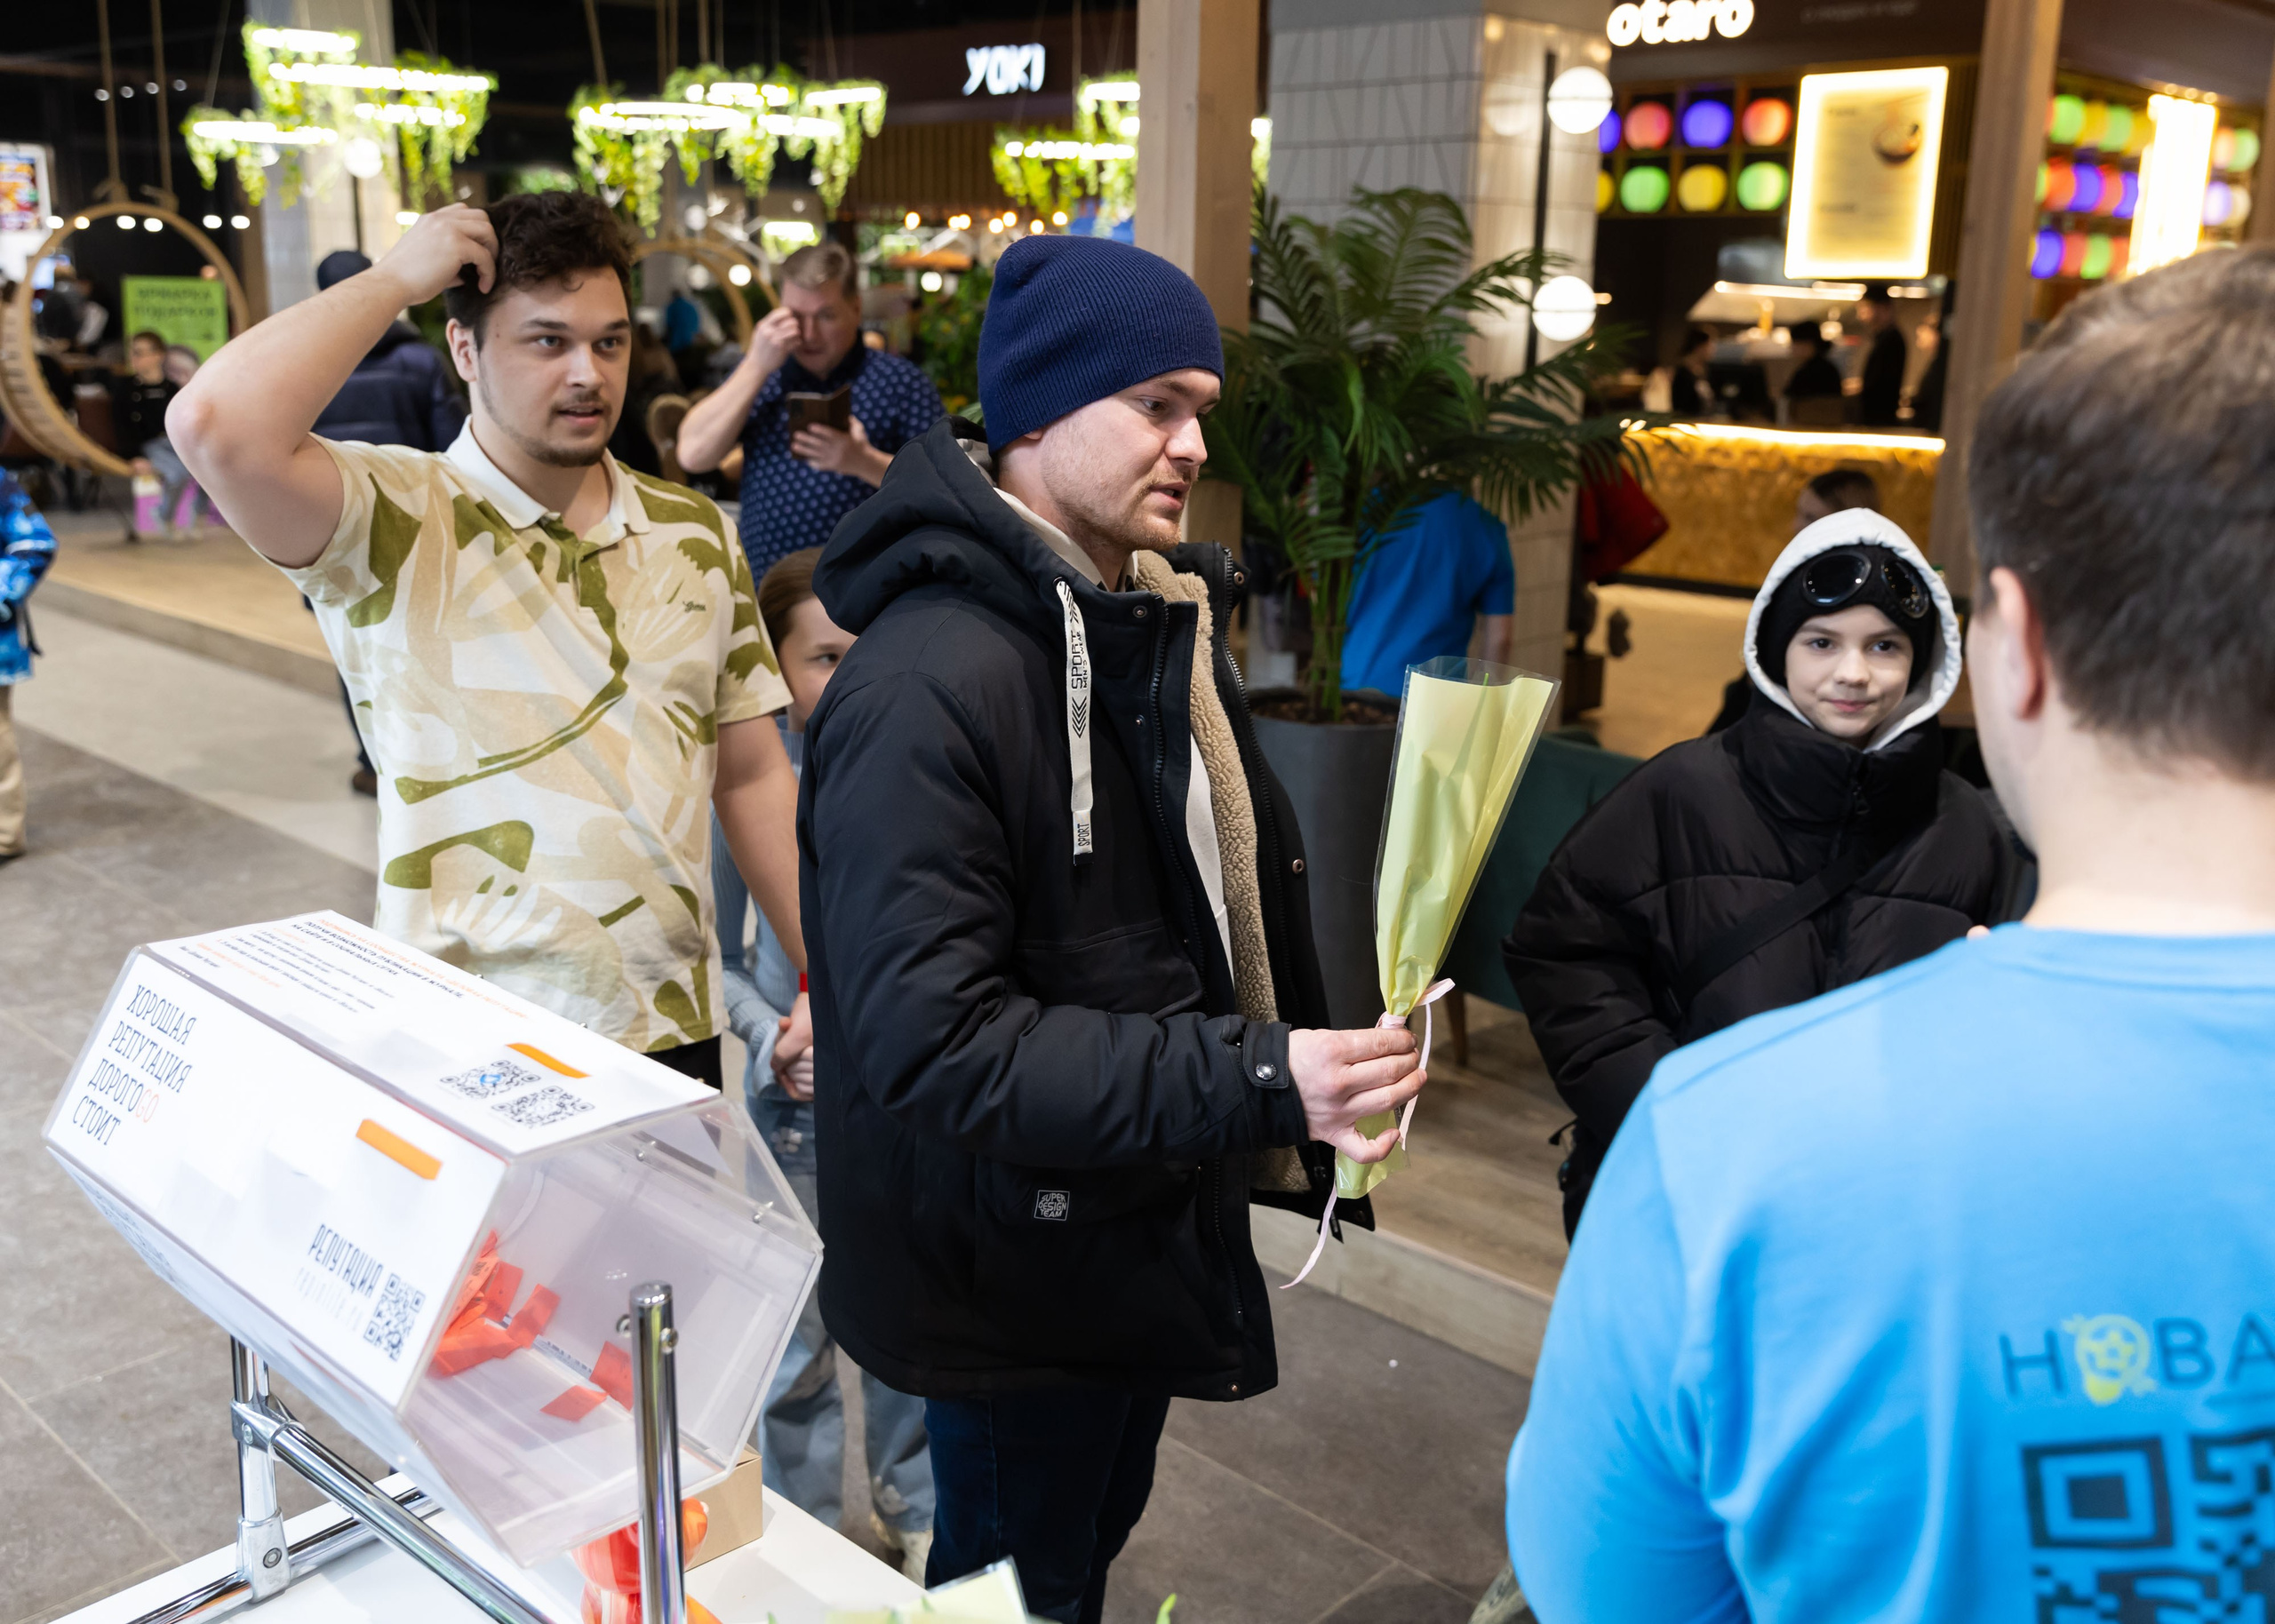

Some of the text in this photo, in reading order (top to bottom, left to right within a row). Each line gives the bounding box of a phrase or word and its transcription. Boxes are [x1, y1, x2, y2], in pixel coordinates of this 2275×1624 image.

[962, 43, 1045, 96] YOKI
[1071, 630, 1082, 689] SPORT
[1077, 824, 1090, 847] SPORT
[300, 929, 323, 938] САЙТЕ
[331, 943, 377, 965] СОЦИАЛЬНЫХ
[305, 922, 331, 934] ПОЛУЧИ
[329, 934, 377, 956] ВОЗМОЖНОСТЬ
[377, 956, 423, 977] ПУБЛИКАЦИИ
[126, 984, 196, 1045] ХОРОШАЯ
[108, 1020, 192, 1093] РЕПУТАЦИЯ
[73, 1095, 121, 1146] СТОИТ
[1038, 1201, 1067, 1211] DESIGN
[1040, 1208, 1063, 1217] TEAM
[1041, 1193, 1066, 1202] SUPER
